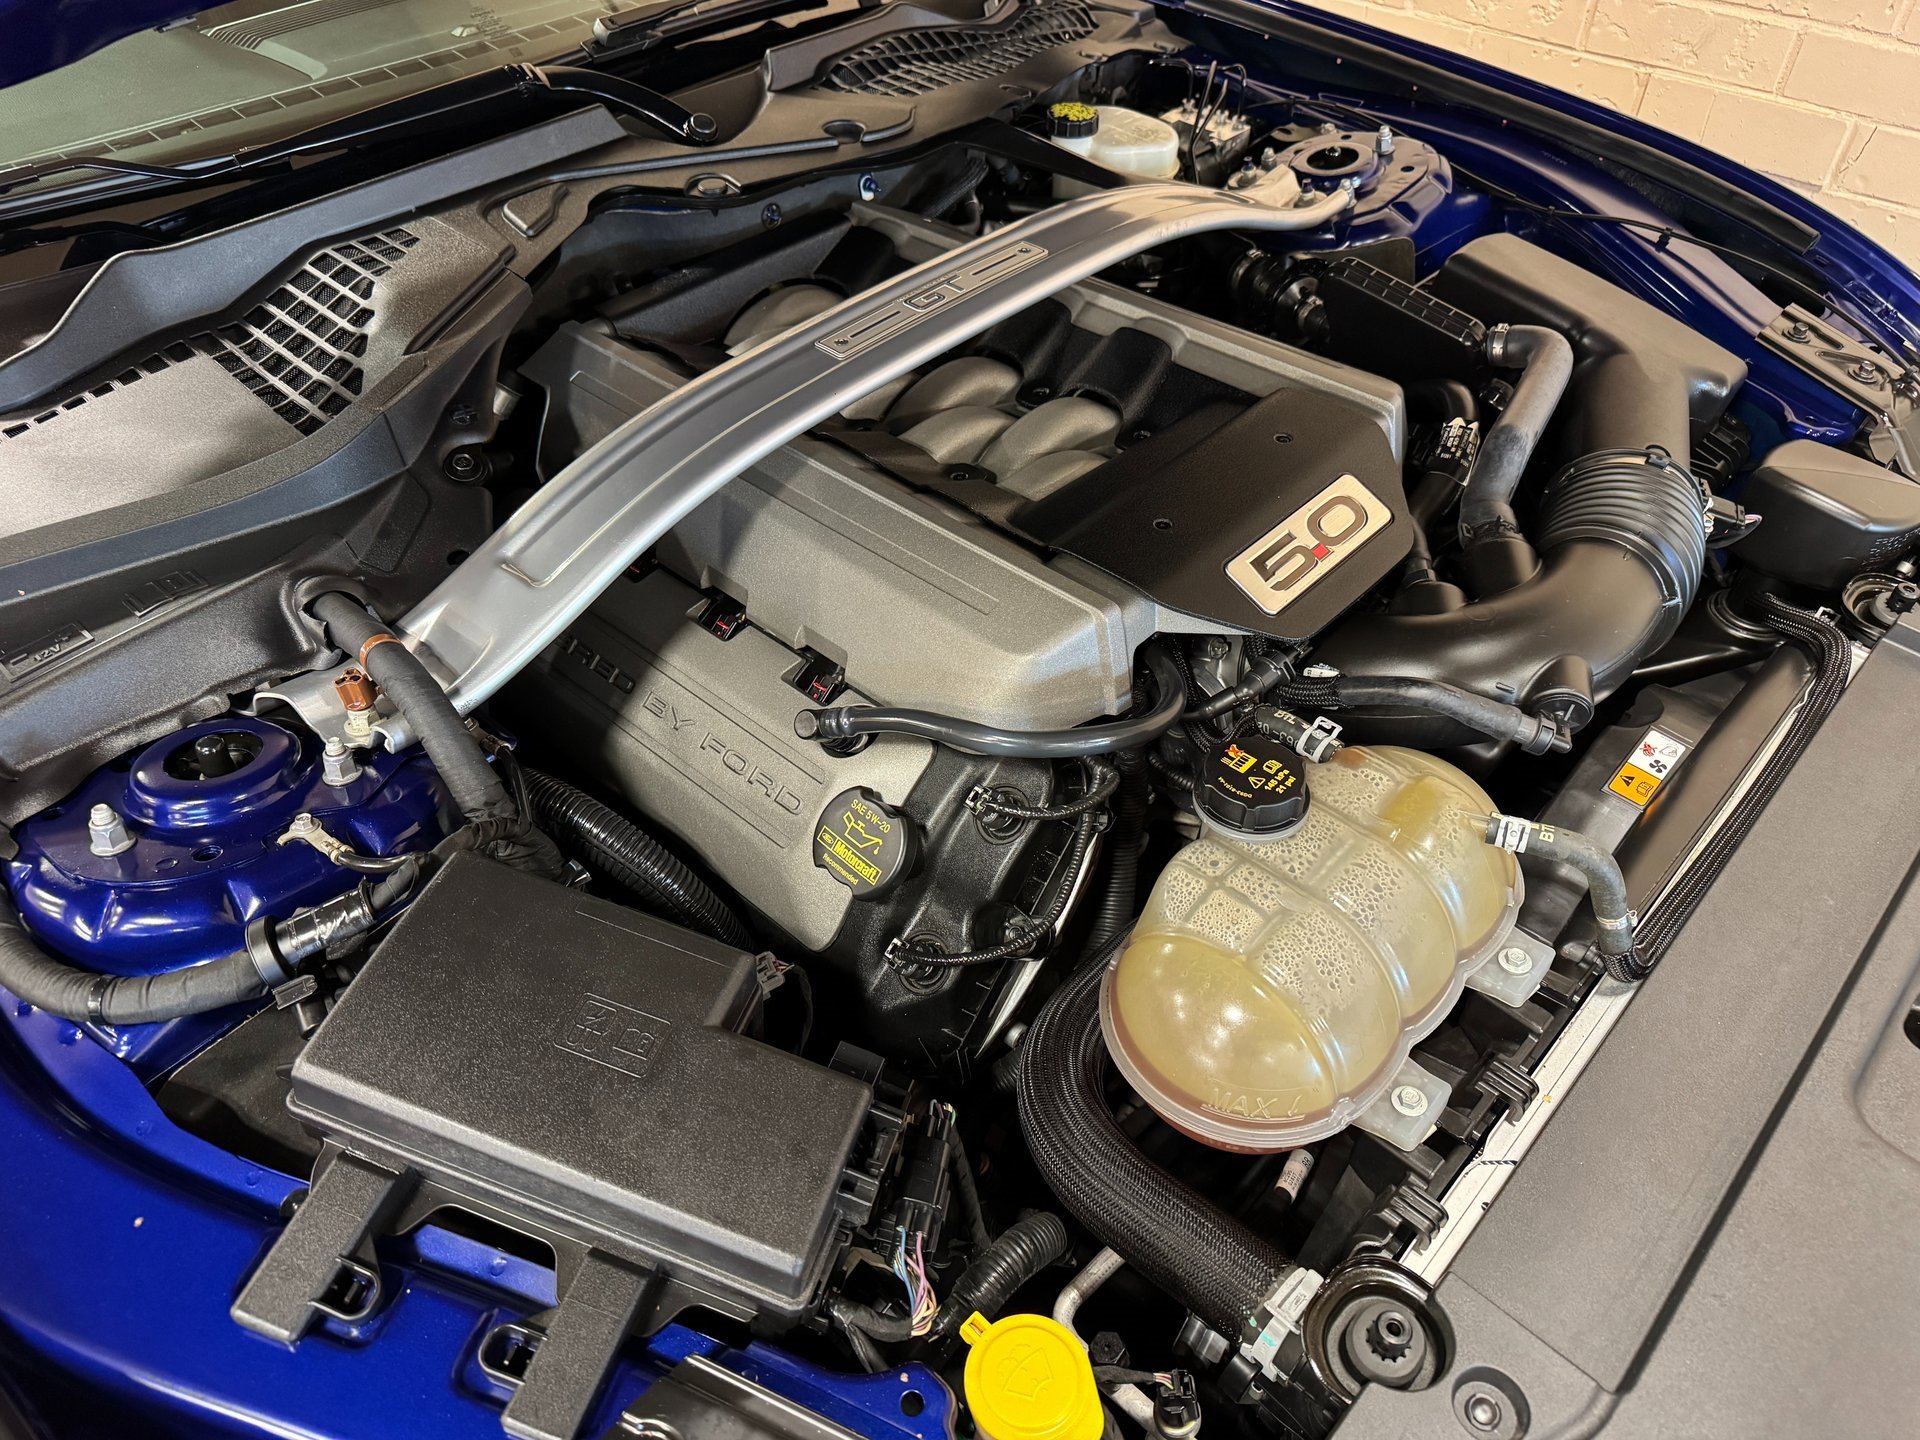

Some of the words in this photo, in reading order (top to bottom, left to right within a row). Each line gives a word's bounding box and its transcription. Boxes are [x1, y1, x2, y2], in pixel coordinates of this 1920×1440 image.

[902, 274, 966, 312] GT
[1249, 495, 1368, 592] 5.0
[34, 644, 61, 661] 12V
[643, 691, 696, 732] BY
[700, 732, 802, 816] FORD
[1264, 779, 1278, 790] 145
[1274, 769, 1290, 781] kPa
[1276, 784, 1287, 794] 21
[1285, 776, 1296, 787] psi
[851, 800, 868, 815] SAE
[865, 810, 891, 833] 5W-20
[822, 853, 859, 886] Recommended
[833, 841, 878, 882] Motorcraft
[1206, 1087, 1279, 1119] MAX
